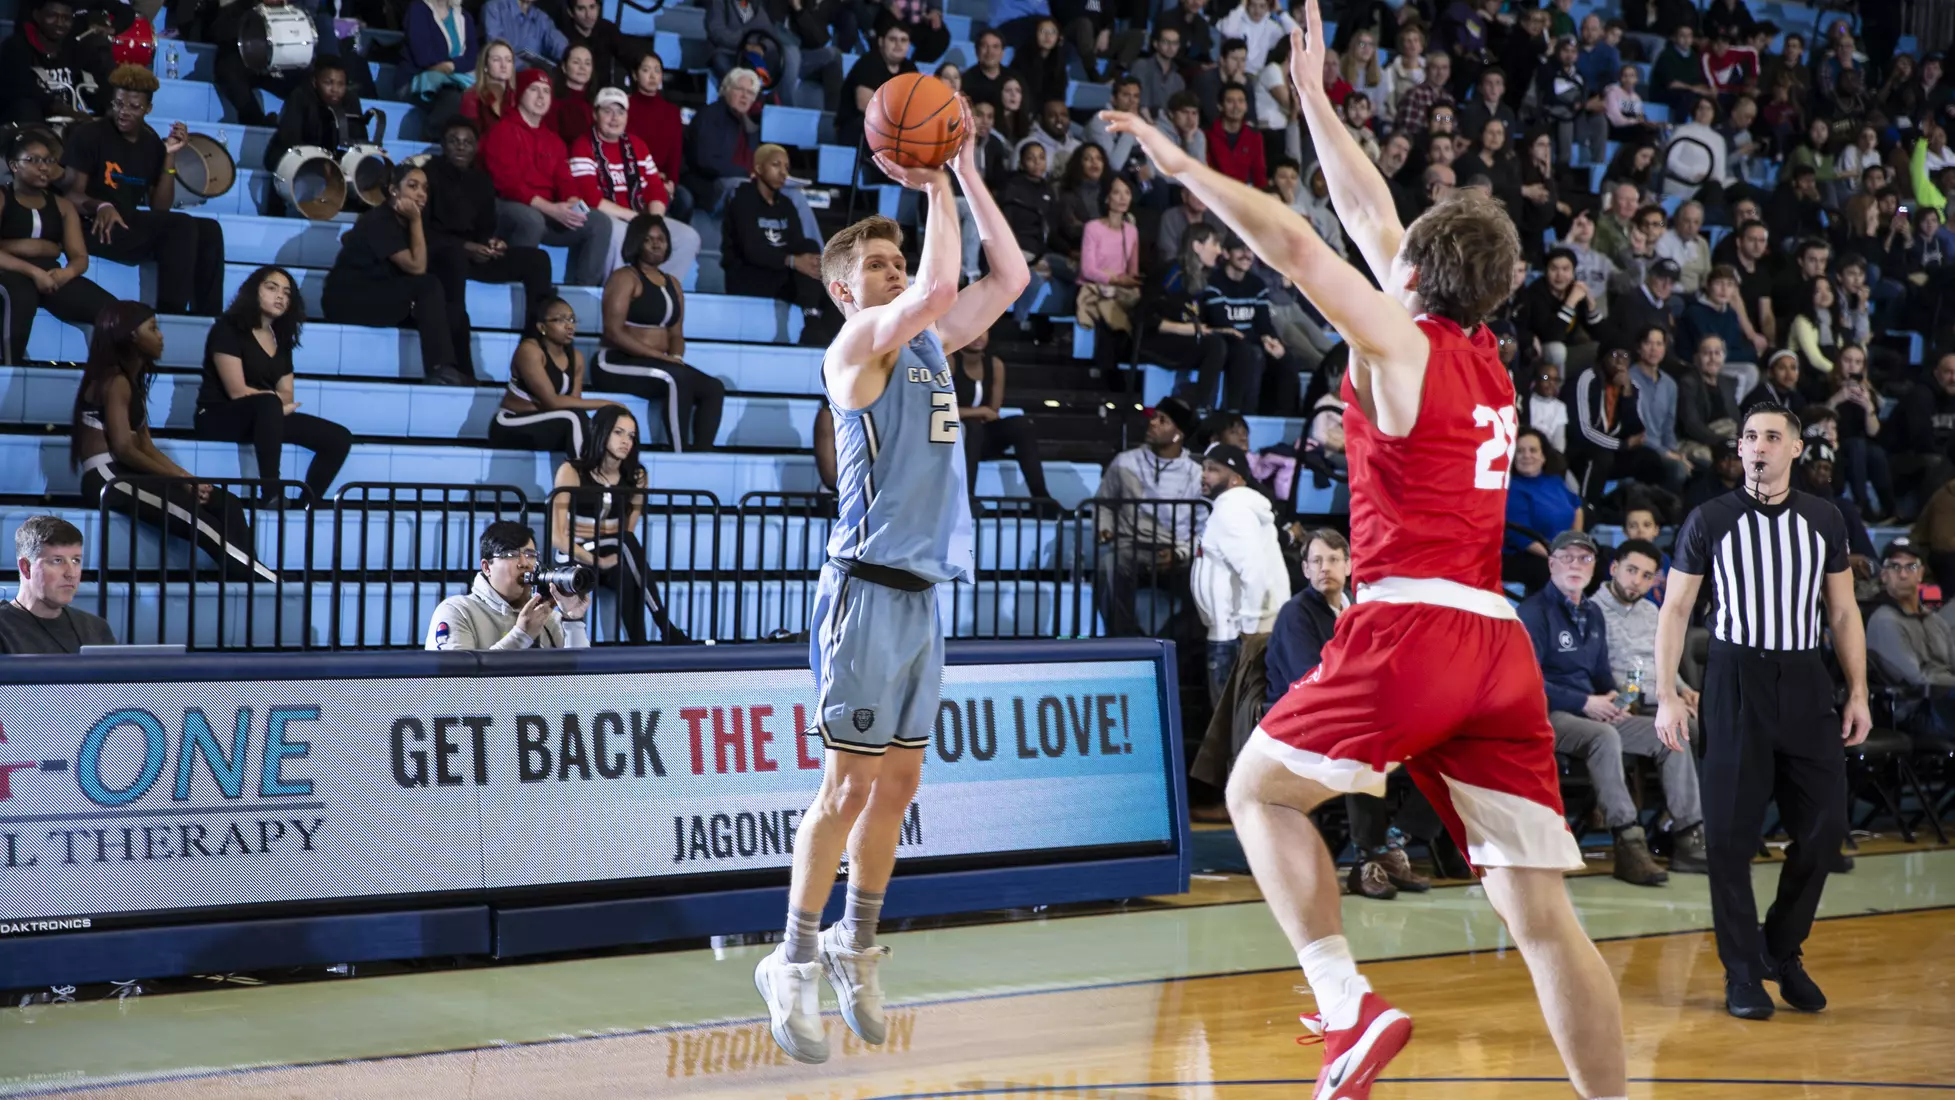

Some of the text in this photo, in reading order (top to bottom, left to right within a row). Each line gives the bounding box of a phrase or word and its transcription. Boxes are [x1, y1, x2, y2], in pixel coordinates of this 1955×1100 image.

[390, 713, 492, 788] GET
[516, 708, 667, 783] BACK
[680, 704, 778, 775] THE
[934, 697, 998, 763] OU
[1012, 693, 1133, 759] LOVE!
[52, 818, 325, 865] THERAPY
[0, 918, 92, 934] DAKTRONICS
